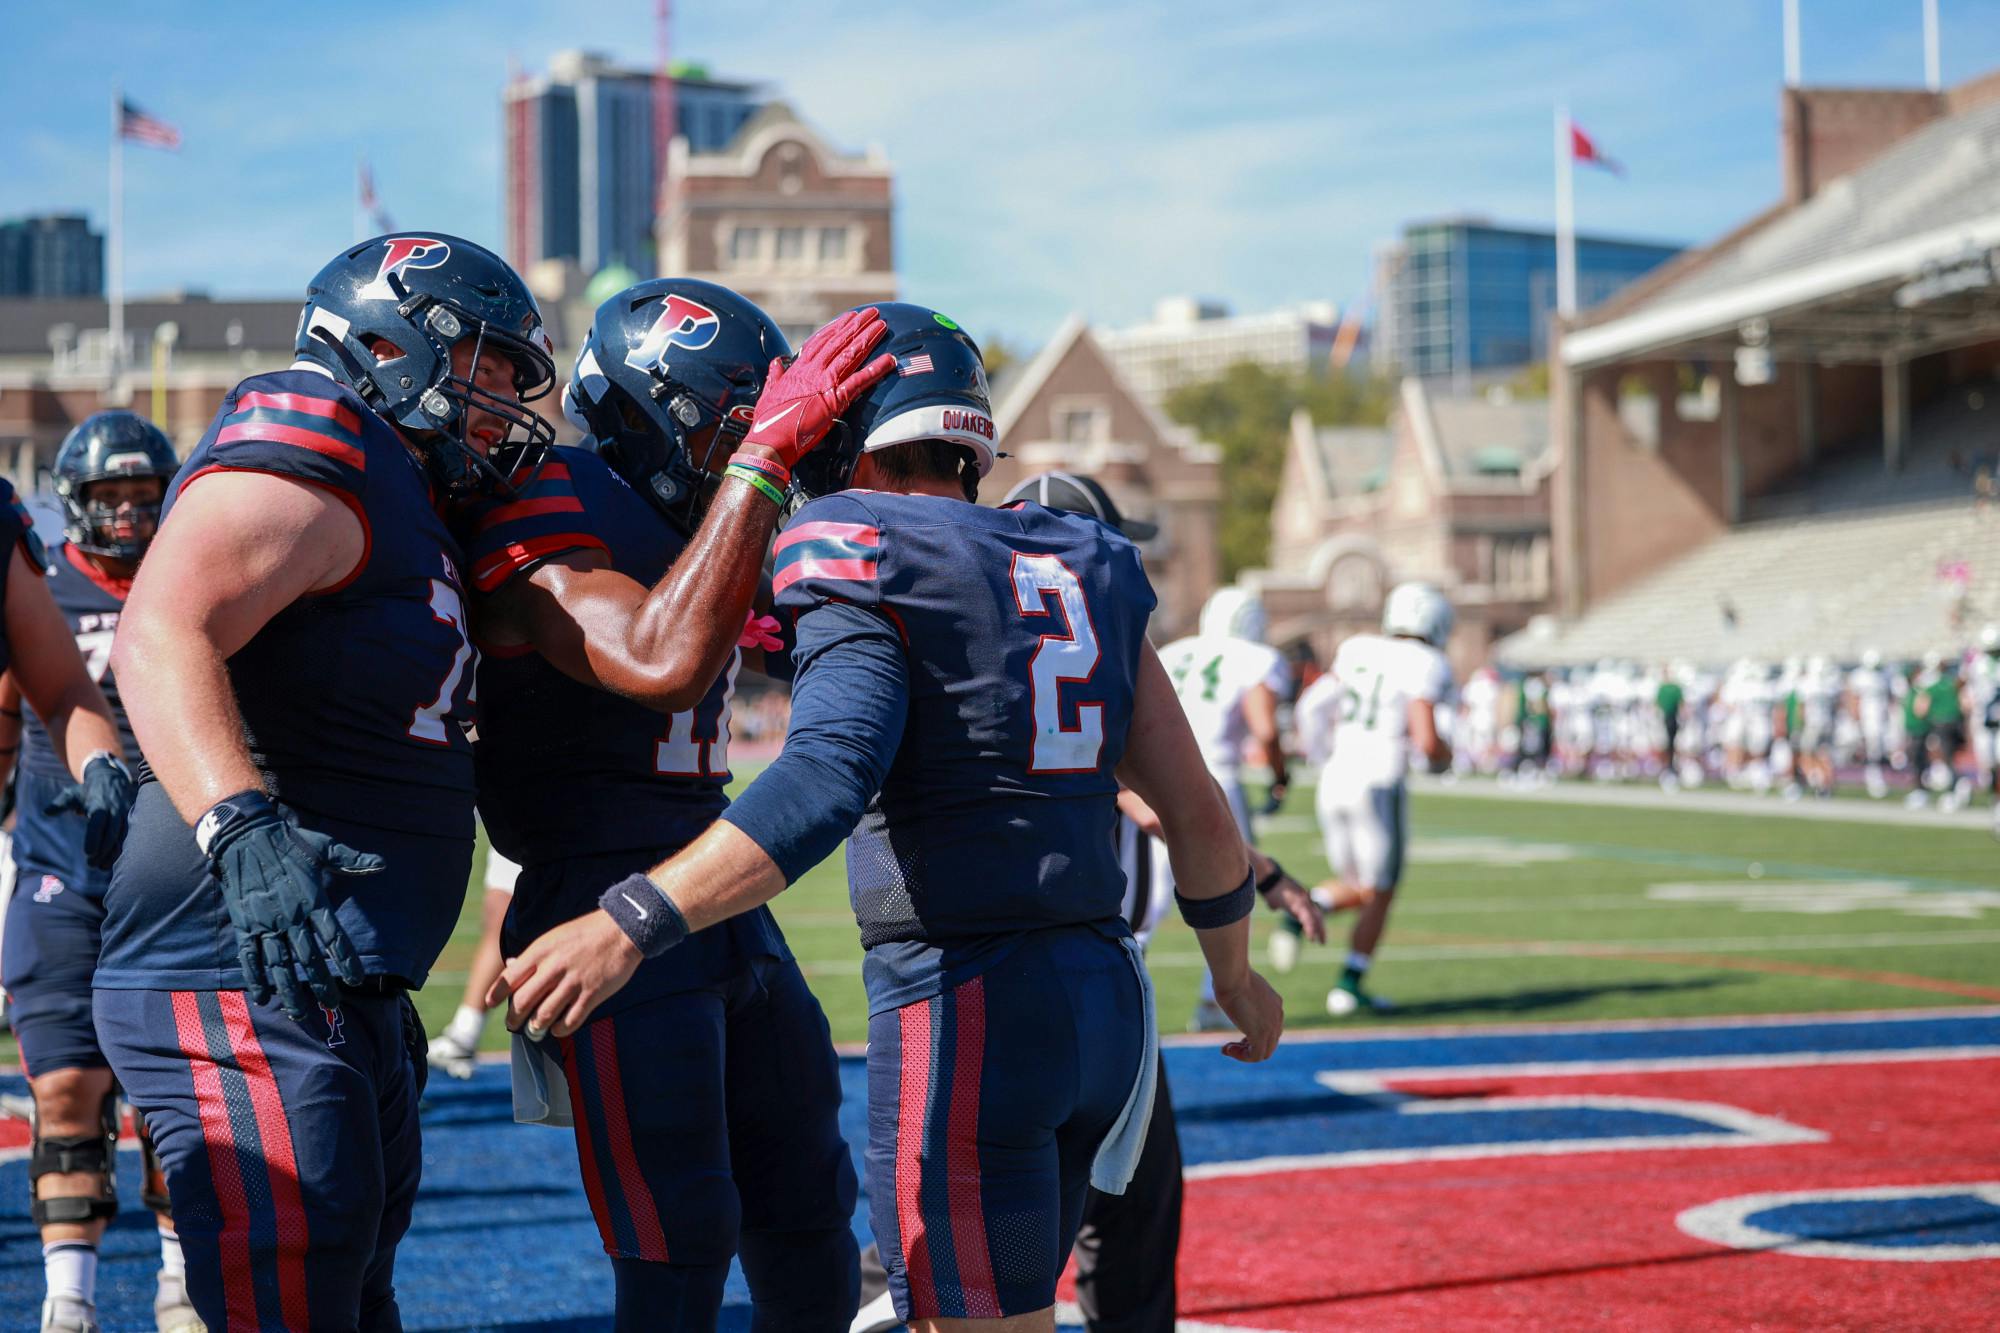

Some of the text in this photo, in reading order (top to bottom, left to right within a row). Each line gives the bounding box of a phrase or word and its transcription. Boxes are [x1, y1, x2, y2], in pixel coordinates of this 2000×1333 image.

[623, 292, 720, 377] P
[943, 409, 994, 441] QUAKERS
[1010, 550, 1105, 775] 2
